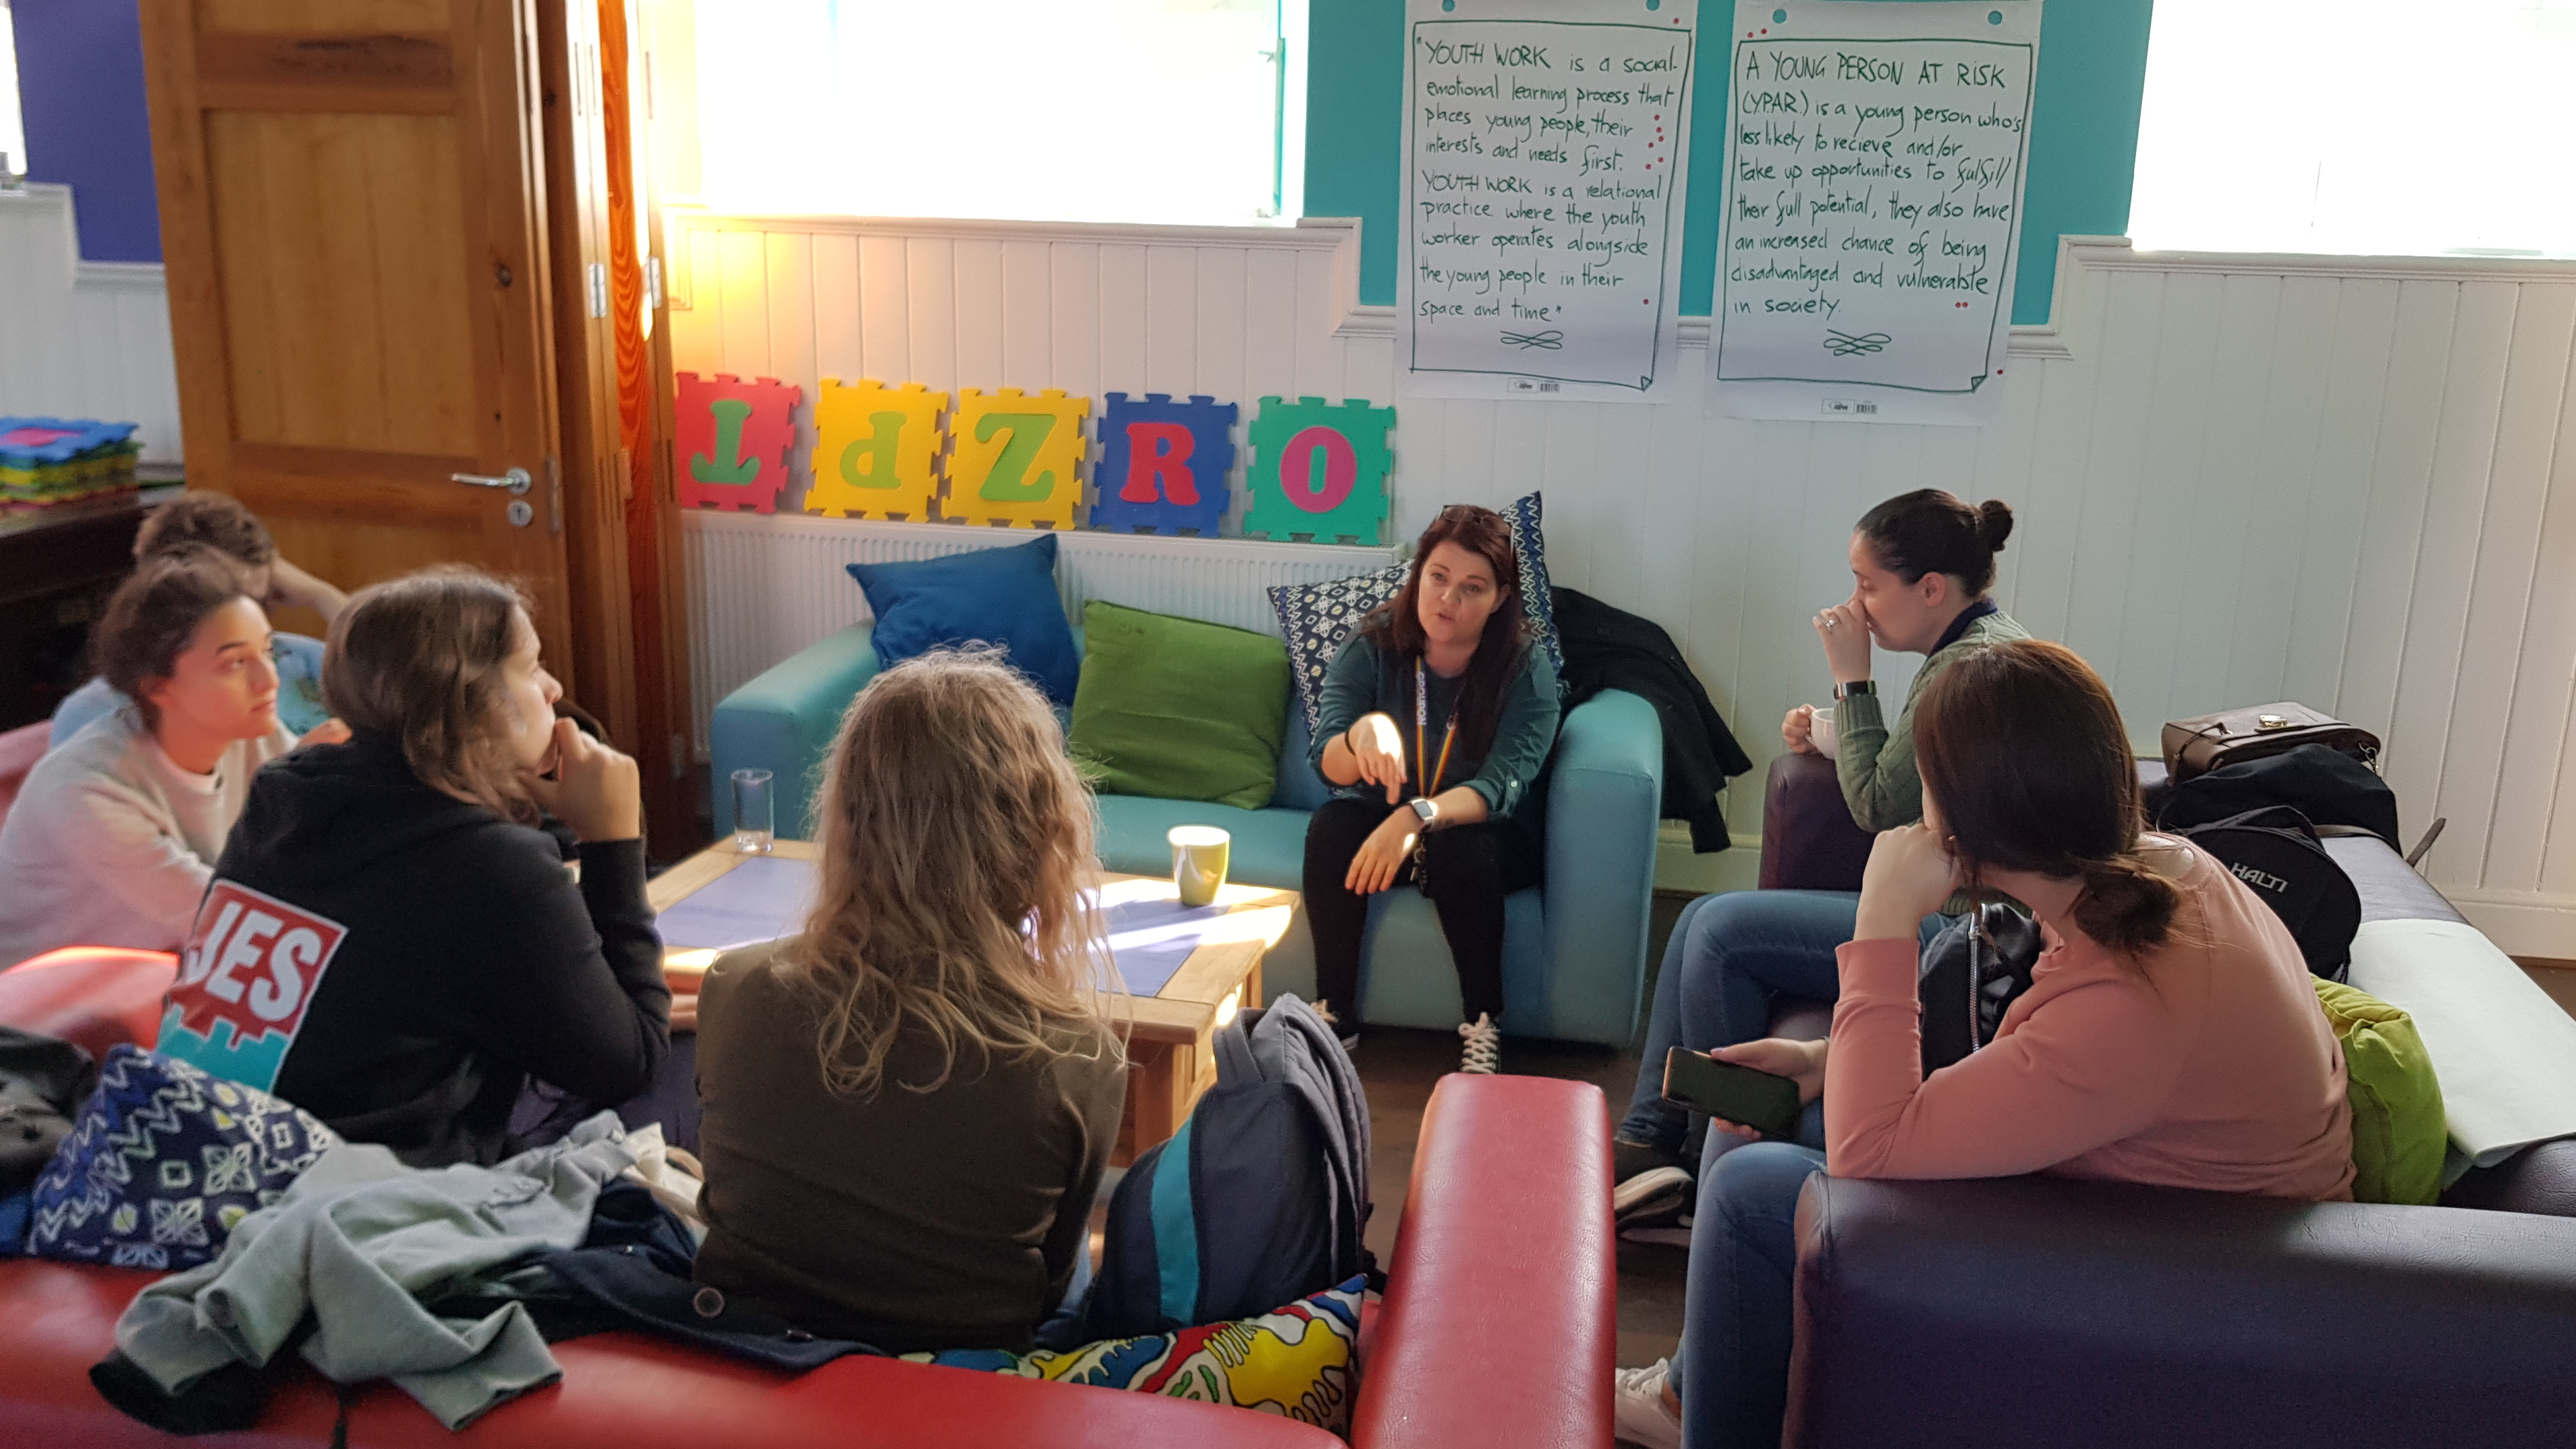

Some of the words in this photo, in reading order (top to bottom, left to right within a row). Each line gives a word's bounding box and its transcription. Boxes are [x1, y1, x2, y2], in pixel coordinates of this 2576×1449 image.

[1494, 43, 1551, 68] WORK
[1570, 54, 1584, 72] is
[1599, 57, 1610, 72] a
[1747, 51, 1760, 81] A
[1770, 51, 1827, 82] YOUNG
[1837, 52, 1903, 86] PERSON
[1918, 61, 1943, 85] AT
[1957, 60, 2005, 88] RISK
[1427, 74, 1499, 99] emotional
[1512, 75, 1567, 113] learning
[1576, 88, 1630, 109] process
[1638, 82, 1675, 107] that
[1425, 102, 1471, 128] places
[1485, 115, 1532, 142] young
[1592, 109, 1633, 139] their
[1815, 100, 1830, 116] is
[1835, 103, 1846, 115] a
[1854, 103, 1904, 138] young
[1914, 105, 1971, 134] person
[1978, 101, 2022, 133] who's
[1426, 136, 1483, 155] interests
[1492, 137, 1519, 160] and
[1530, 147, 1567, 164] needs
[1579, 145, 1623, 176] first.
[1815, 122, 1828, 152] to
[1833, 133, 1893, 158] recieve
[1906, 134, 1963, 159] and/or
[1422, 169, 1480, 192] YOUTH
[1485, 177, 1532, 194] WORK
[1544, 186, 1557, 197] is
[1562, 188, 1574, 198] a
[1586, 175, 1662, 200] relational
[1739, 154, 1776, 182] take
[1785, 165, 1803, 189] up
[1812, 157, 1912, 188] opportunities
[1926, 159, 1945, 180] to
[1951, 156, 2012, 194] fulfill
[1420, 196, 1494, 222] practice
[1505, 200, 1556, 222] where
[1566, 203, 1594, 225] the
[1602, 202, 1646, 235] youth
[1775, 190, 1801, 227] full
[1810, 184, 1877, 227] potential,
[1888, 190, 1923, 230] they
[1928, 191, 1964, 218] also
[1973, 192, 2010, 221] have
[1422, 222, 1481, 246] worker
[1491, 228, 1554, 258] operates
[1567, 228, 1648, 267] alongside
[1735, 236, 1754, 251] an
[1759, 227, 1827, 250] increased
[1841, 226, 1895, 255] chance
[1908, 229, 1930, 267] of
[1941, 229, 1987, 277] being
[1420, 256, 1445, 283] the
[1447, 268, 1490, 294] young
[1499, 258, 1548, 296] people
[1559, 273, 1575, 287] in
[1583, 263, 1624, 288] their
[1731, 256, 1839, 293] disadvantaged
[1853, 261, 1884, 288] and
[1897, 260, 1990, 295] vulnerable
[1419, 301, 1465, 324] space
[1474, 299, 1500, 317] and
[1735, 303, 1751, 314] in
[974, 413, 1058, 503] Z
[1119, 422, 1201, 507] R
[2231, 862, 2289, 893] HALTI
